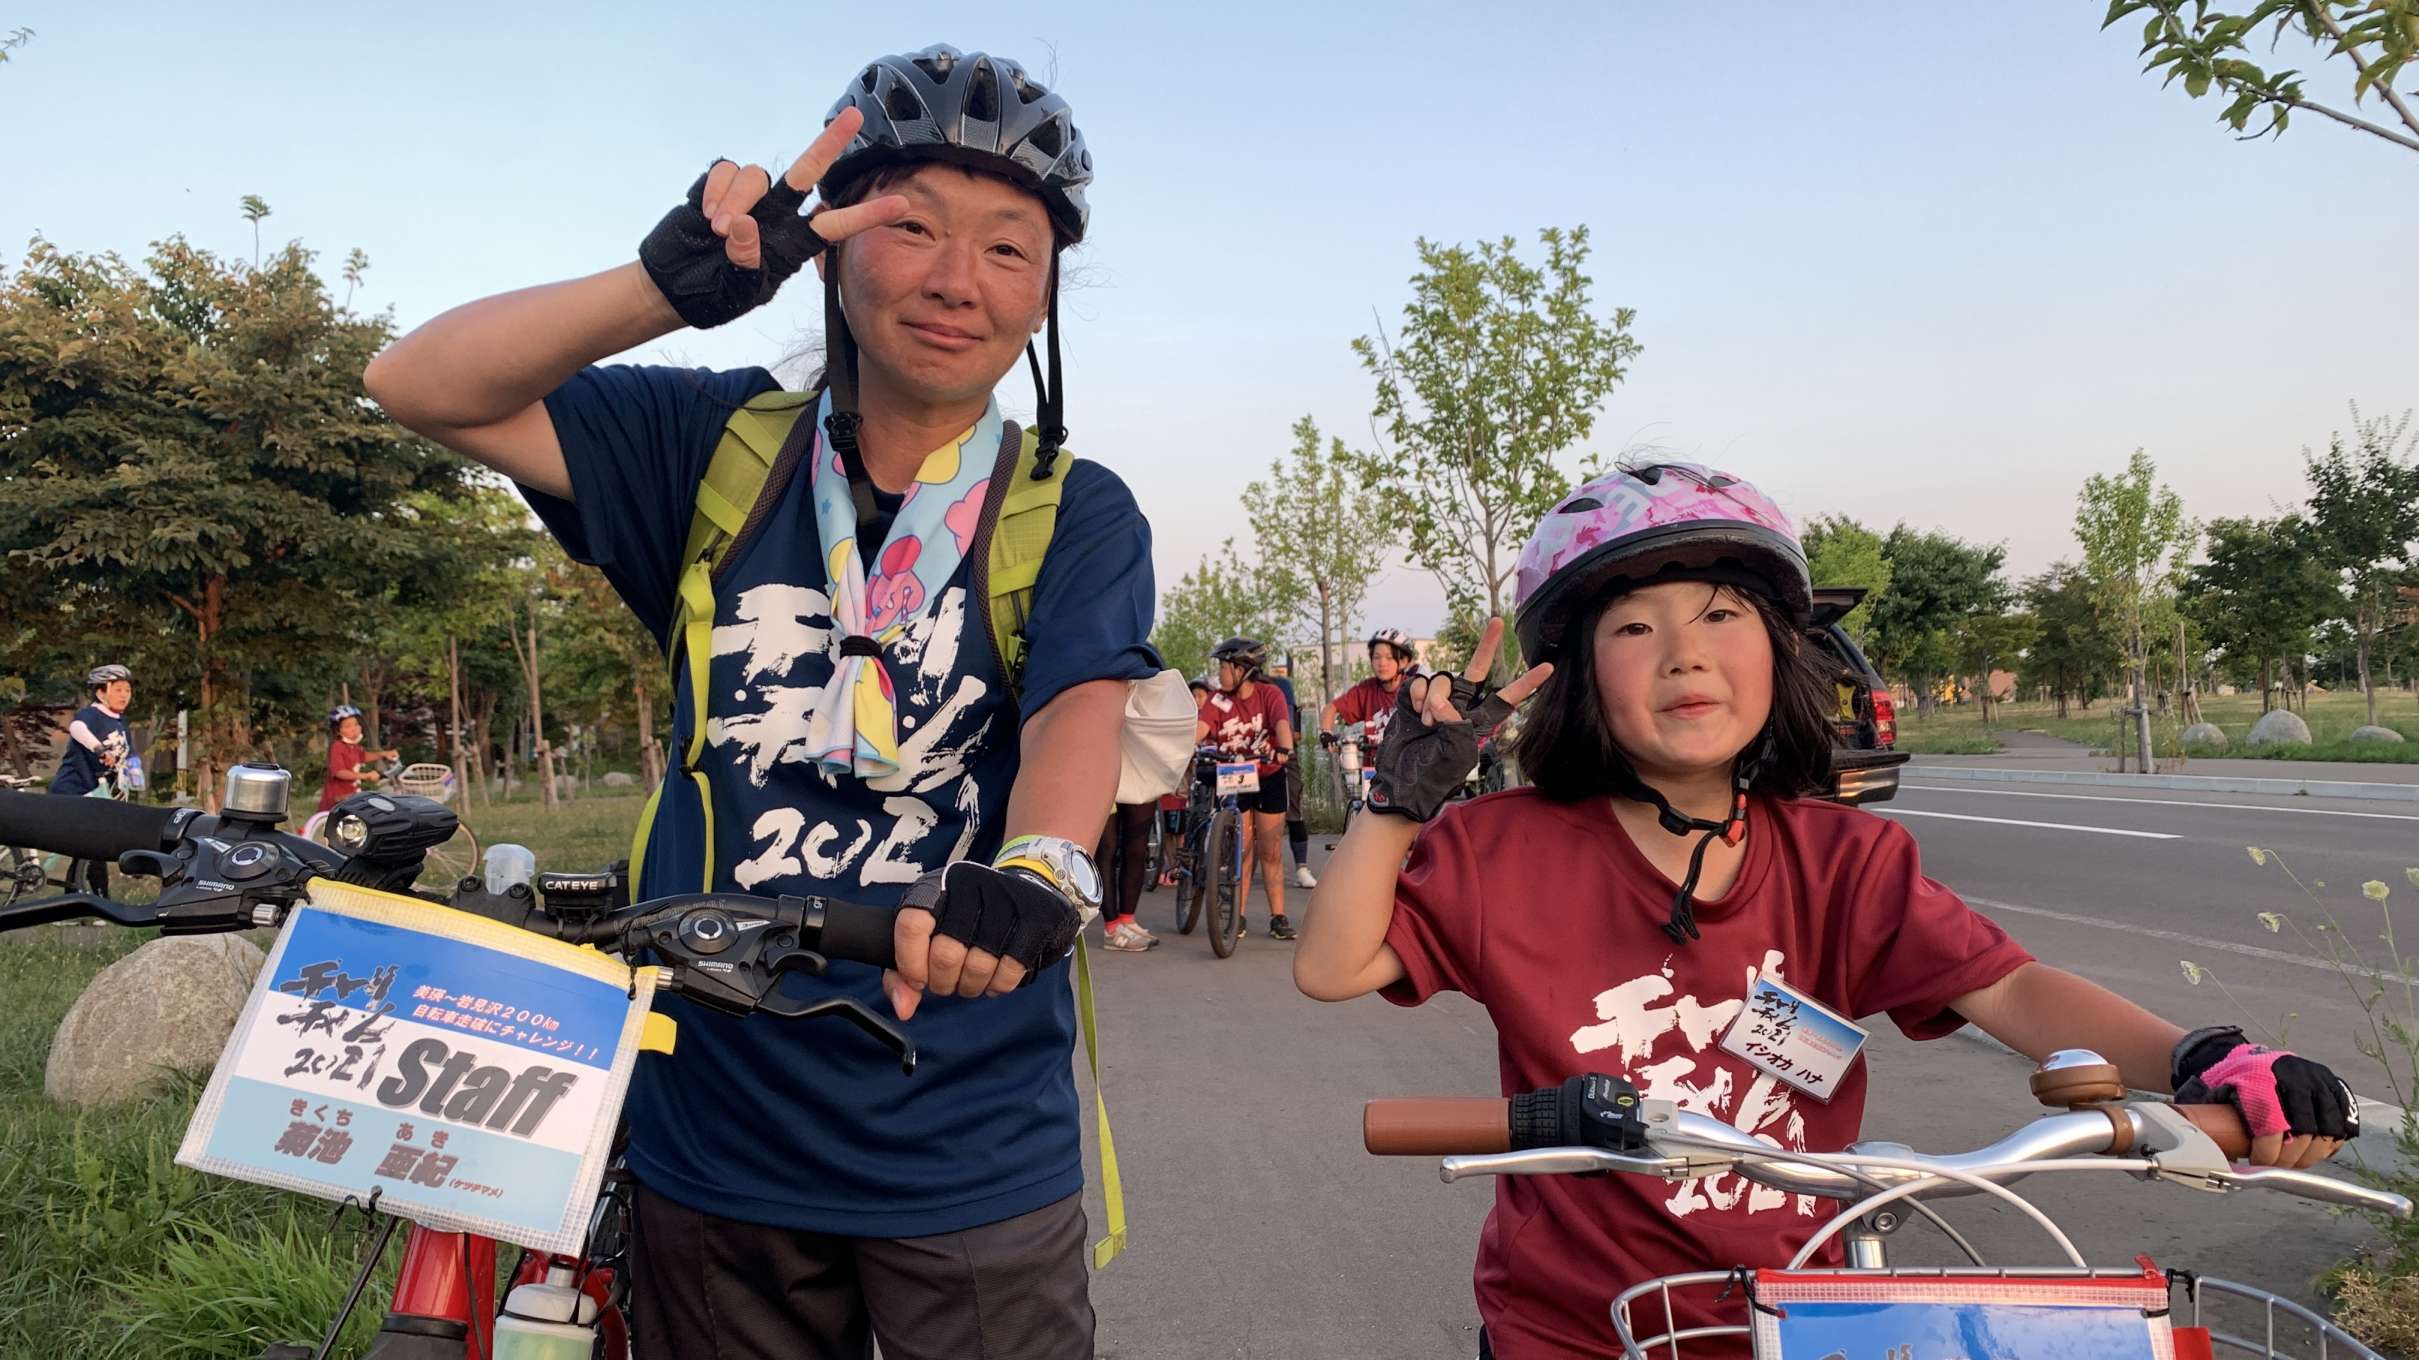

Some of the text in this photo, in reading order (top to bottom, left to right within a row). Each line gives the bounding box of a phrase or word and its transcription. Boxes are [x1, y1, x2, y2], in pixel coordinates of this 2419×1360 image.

[710, 583, 966, 703] チリ
[198, 880, 235, 891] SHIMANO
[545, 880, 599, 891] CATEYE
[698, 960, 734, 969] SHIMANO
[1751, 1024, 1792, 1046] 2021
[284, 1044, 386, 1091] 2021
[1745, 1041, 1794, 1071] イシオカ
[1796, 1068, 1824, 1084] ハナ
[376, 1037, 580, 1139] Staff
[290, 1098, 353, 1126] きくち
[274, 1120, 354, 1164] 菊池
[396, 1122, 450, 1149] あき
